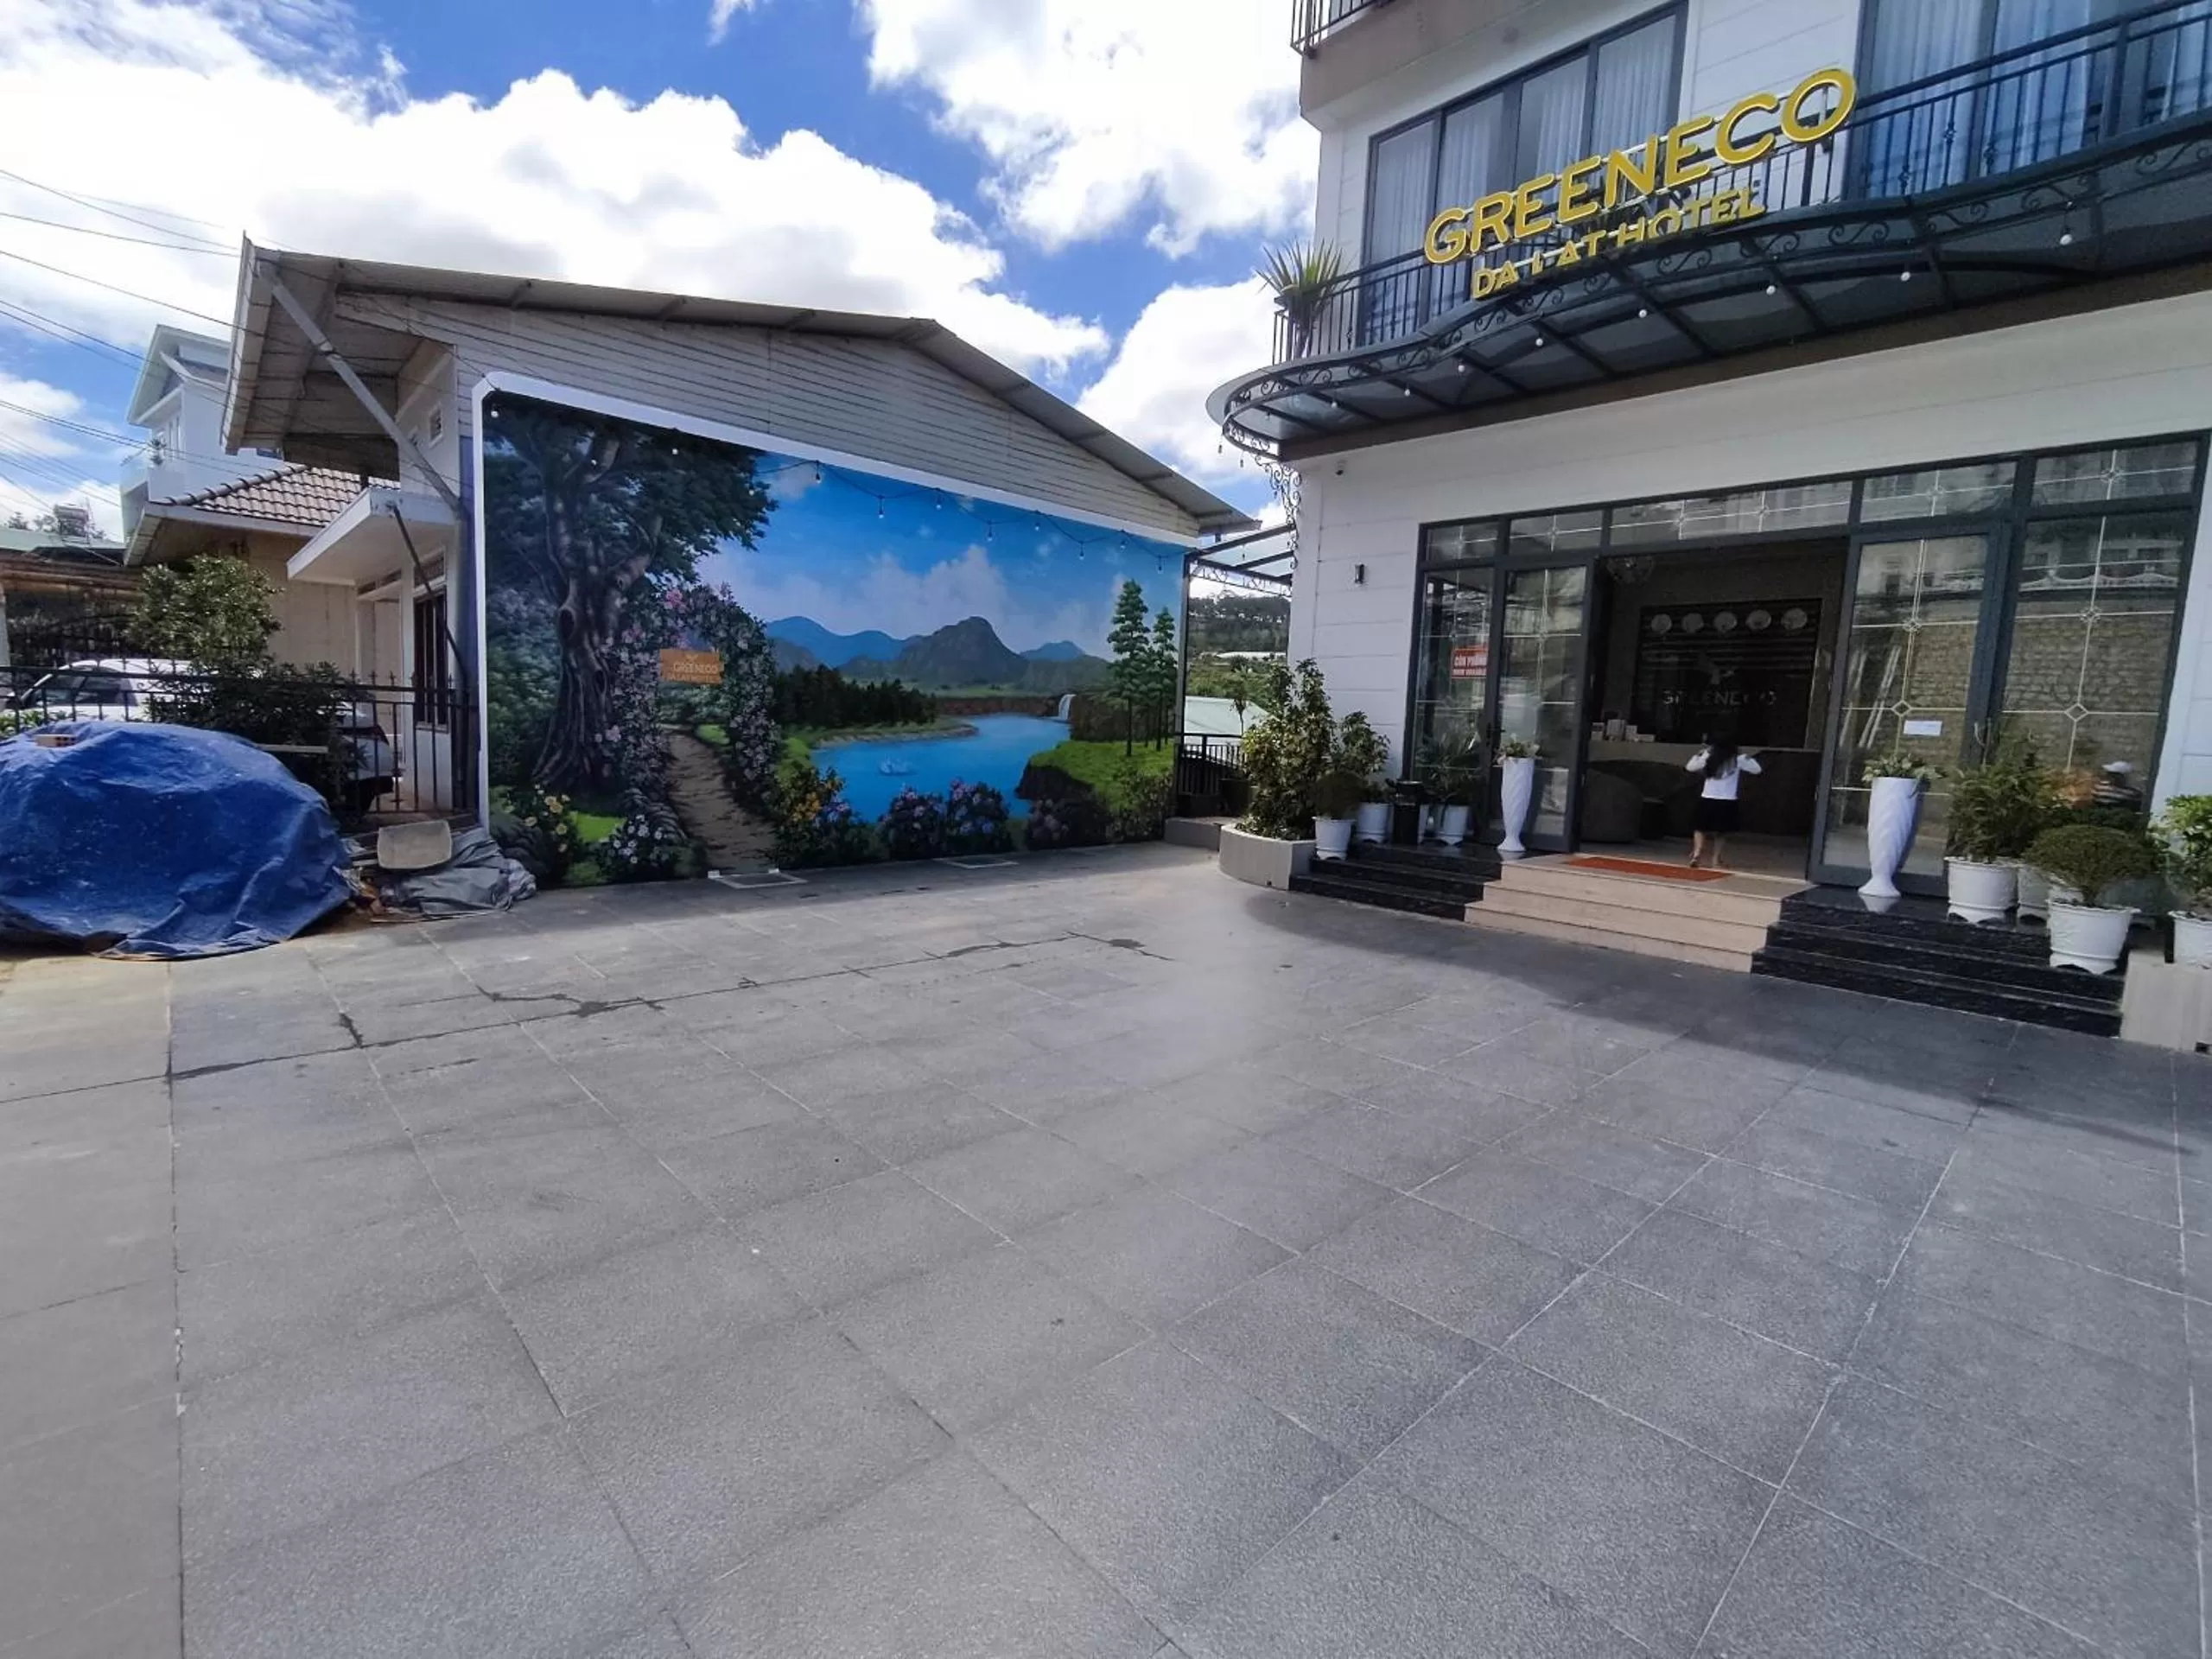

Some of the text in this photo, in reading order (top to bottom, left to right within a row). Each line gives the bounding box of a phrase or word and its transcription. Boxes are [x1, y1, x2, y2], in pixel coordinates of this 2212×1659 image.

[1424, 67, 1857, 264] GREENECO
[1472, 260, 1520, 300] DA
[1617, 186, 1765, 249] HOTEL
